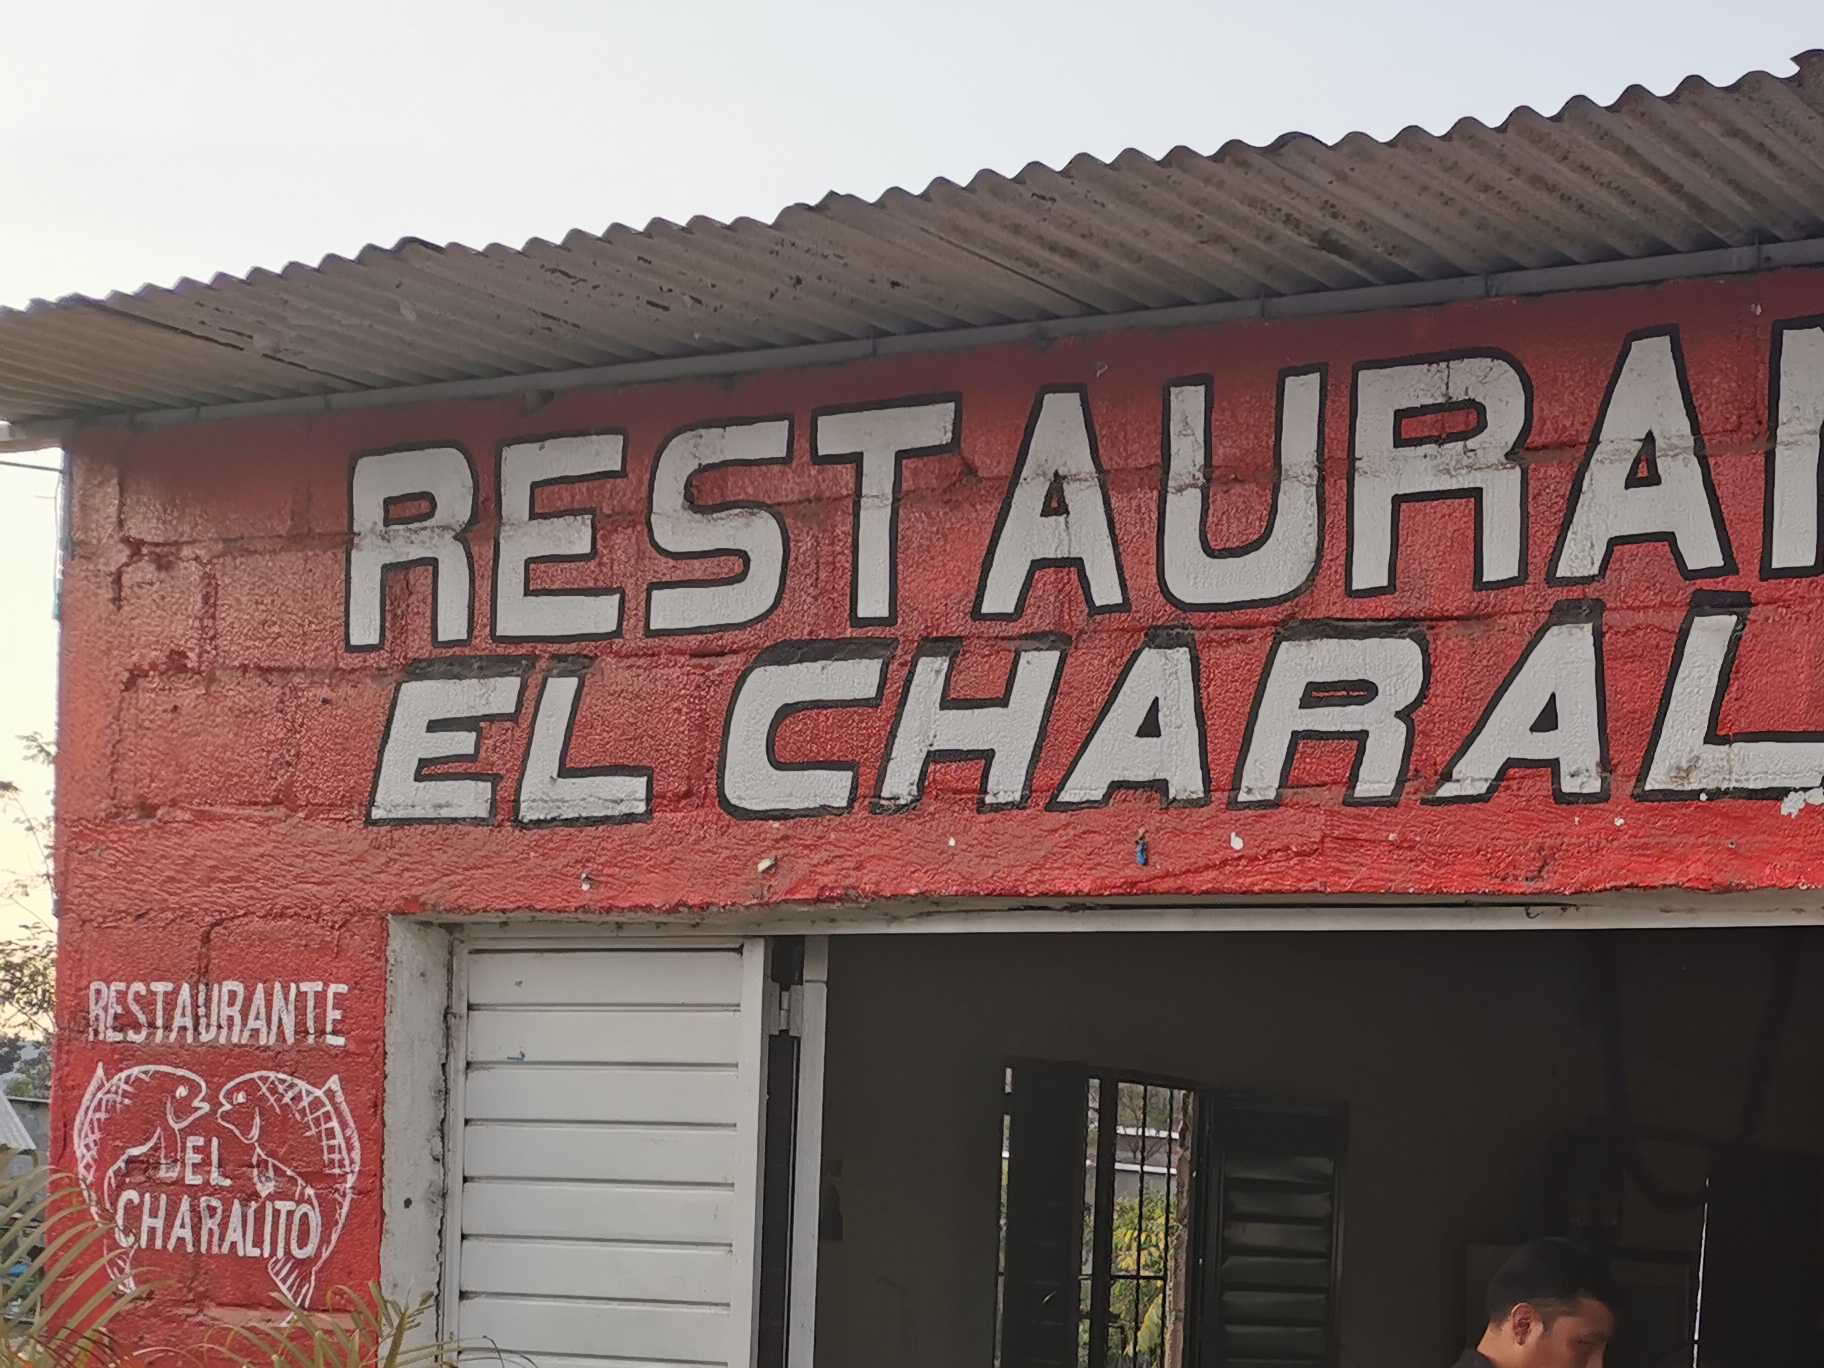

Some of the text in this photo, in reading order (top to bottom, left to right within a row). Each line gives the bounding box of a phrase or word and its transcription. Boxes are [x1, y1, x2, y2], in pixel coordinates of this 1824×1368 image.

[364, 653, 654, 826] EL
[87, 980, 349, 1047] RESTAURANTE
[184, 1135, 232, 1188] EL
[113, 1189, 322, 1260] CHARALITO
